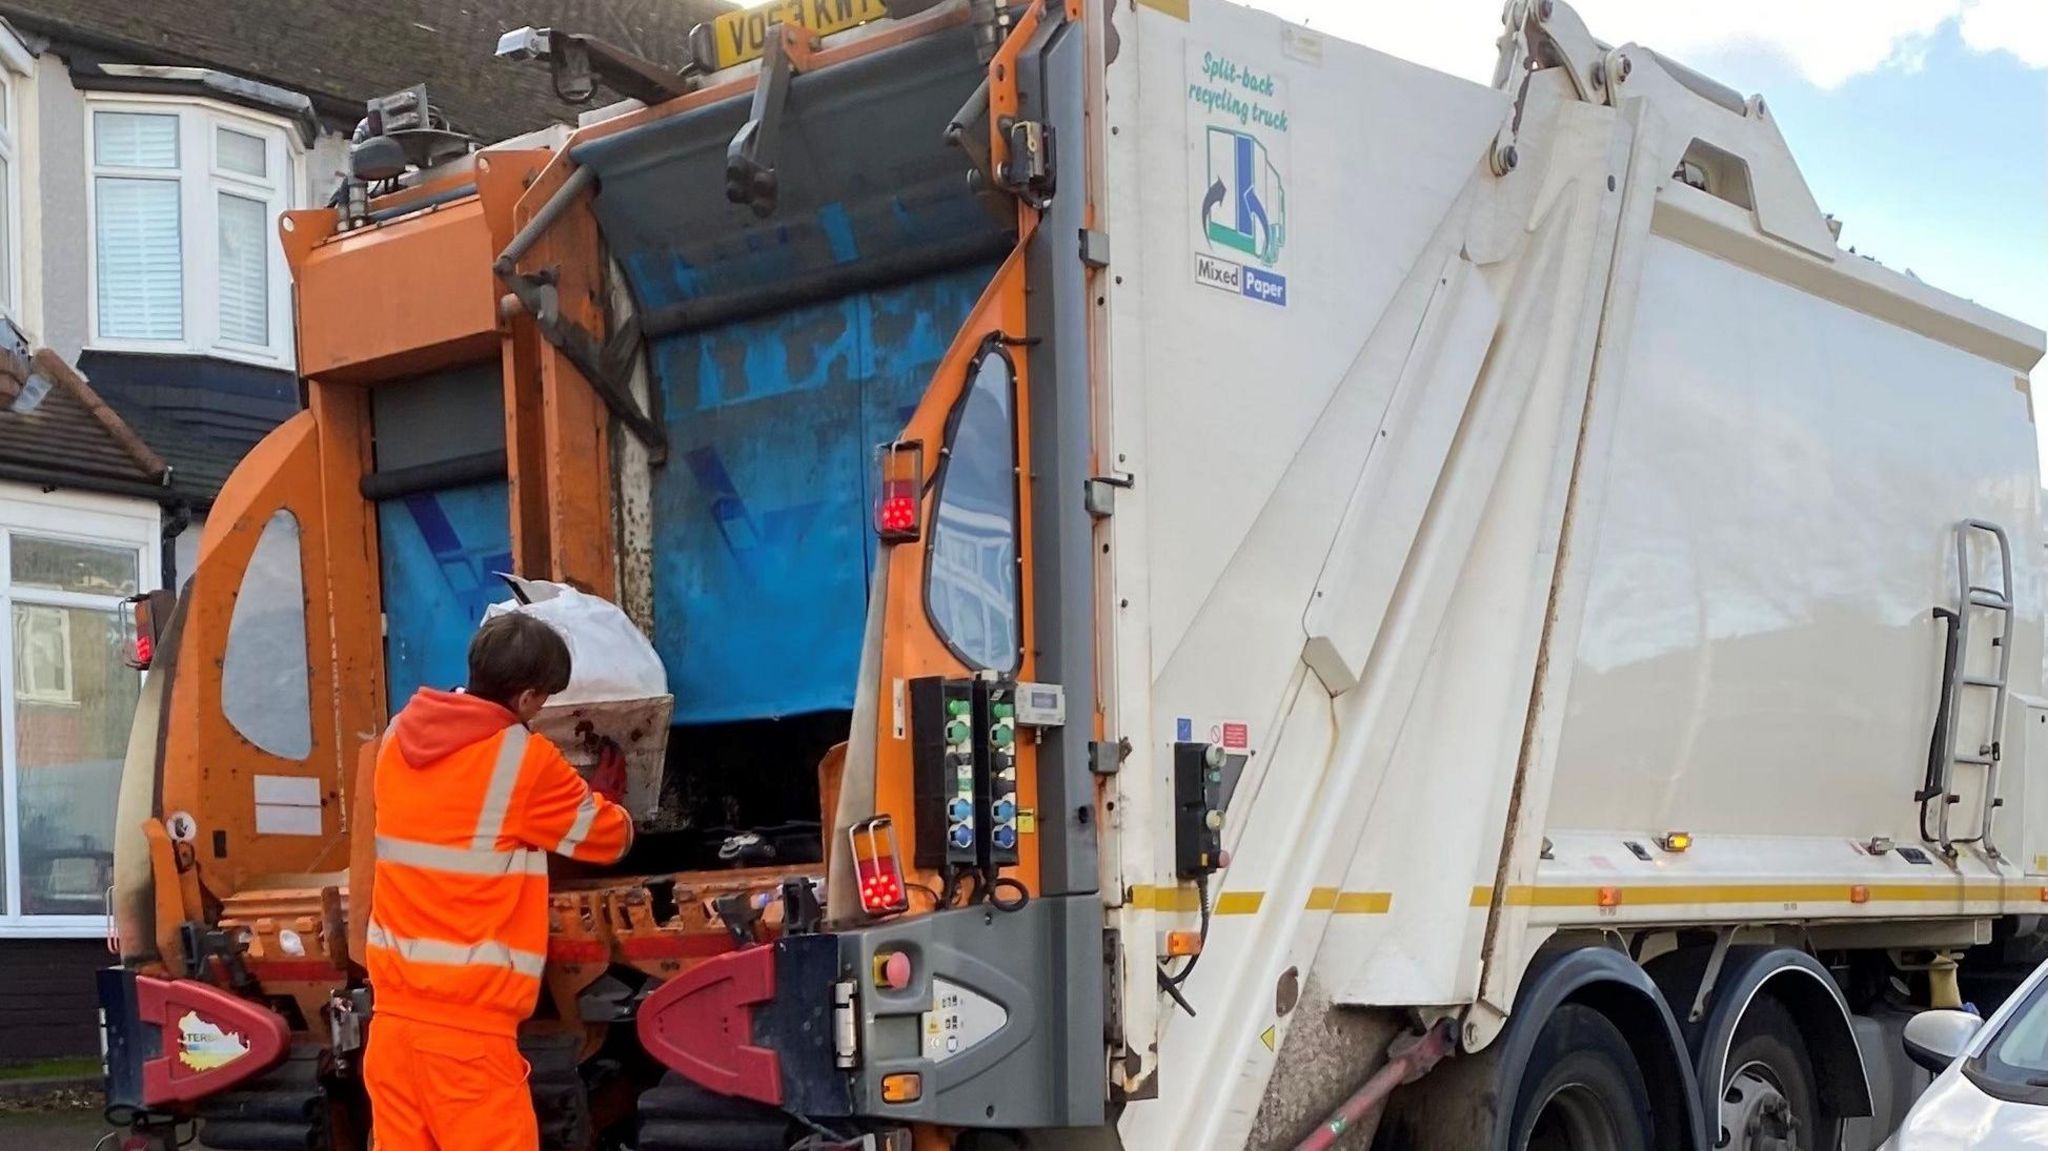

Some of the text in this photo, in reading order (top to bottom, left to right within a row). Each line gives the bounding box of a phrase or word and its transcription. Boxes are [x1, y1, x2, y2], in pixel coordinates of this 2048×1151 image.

[1202, 51, 1273, 97] Split-back
[1189, 84, 1288, 132] recycling truck
[1198, 258, 1283, 299] Mixed Paper
